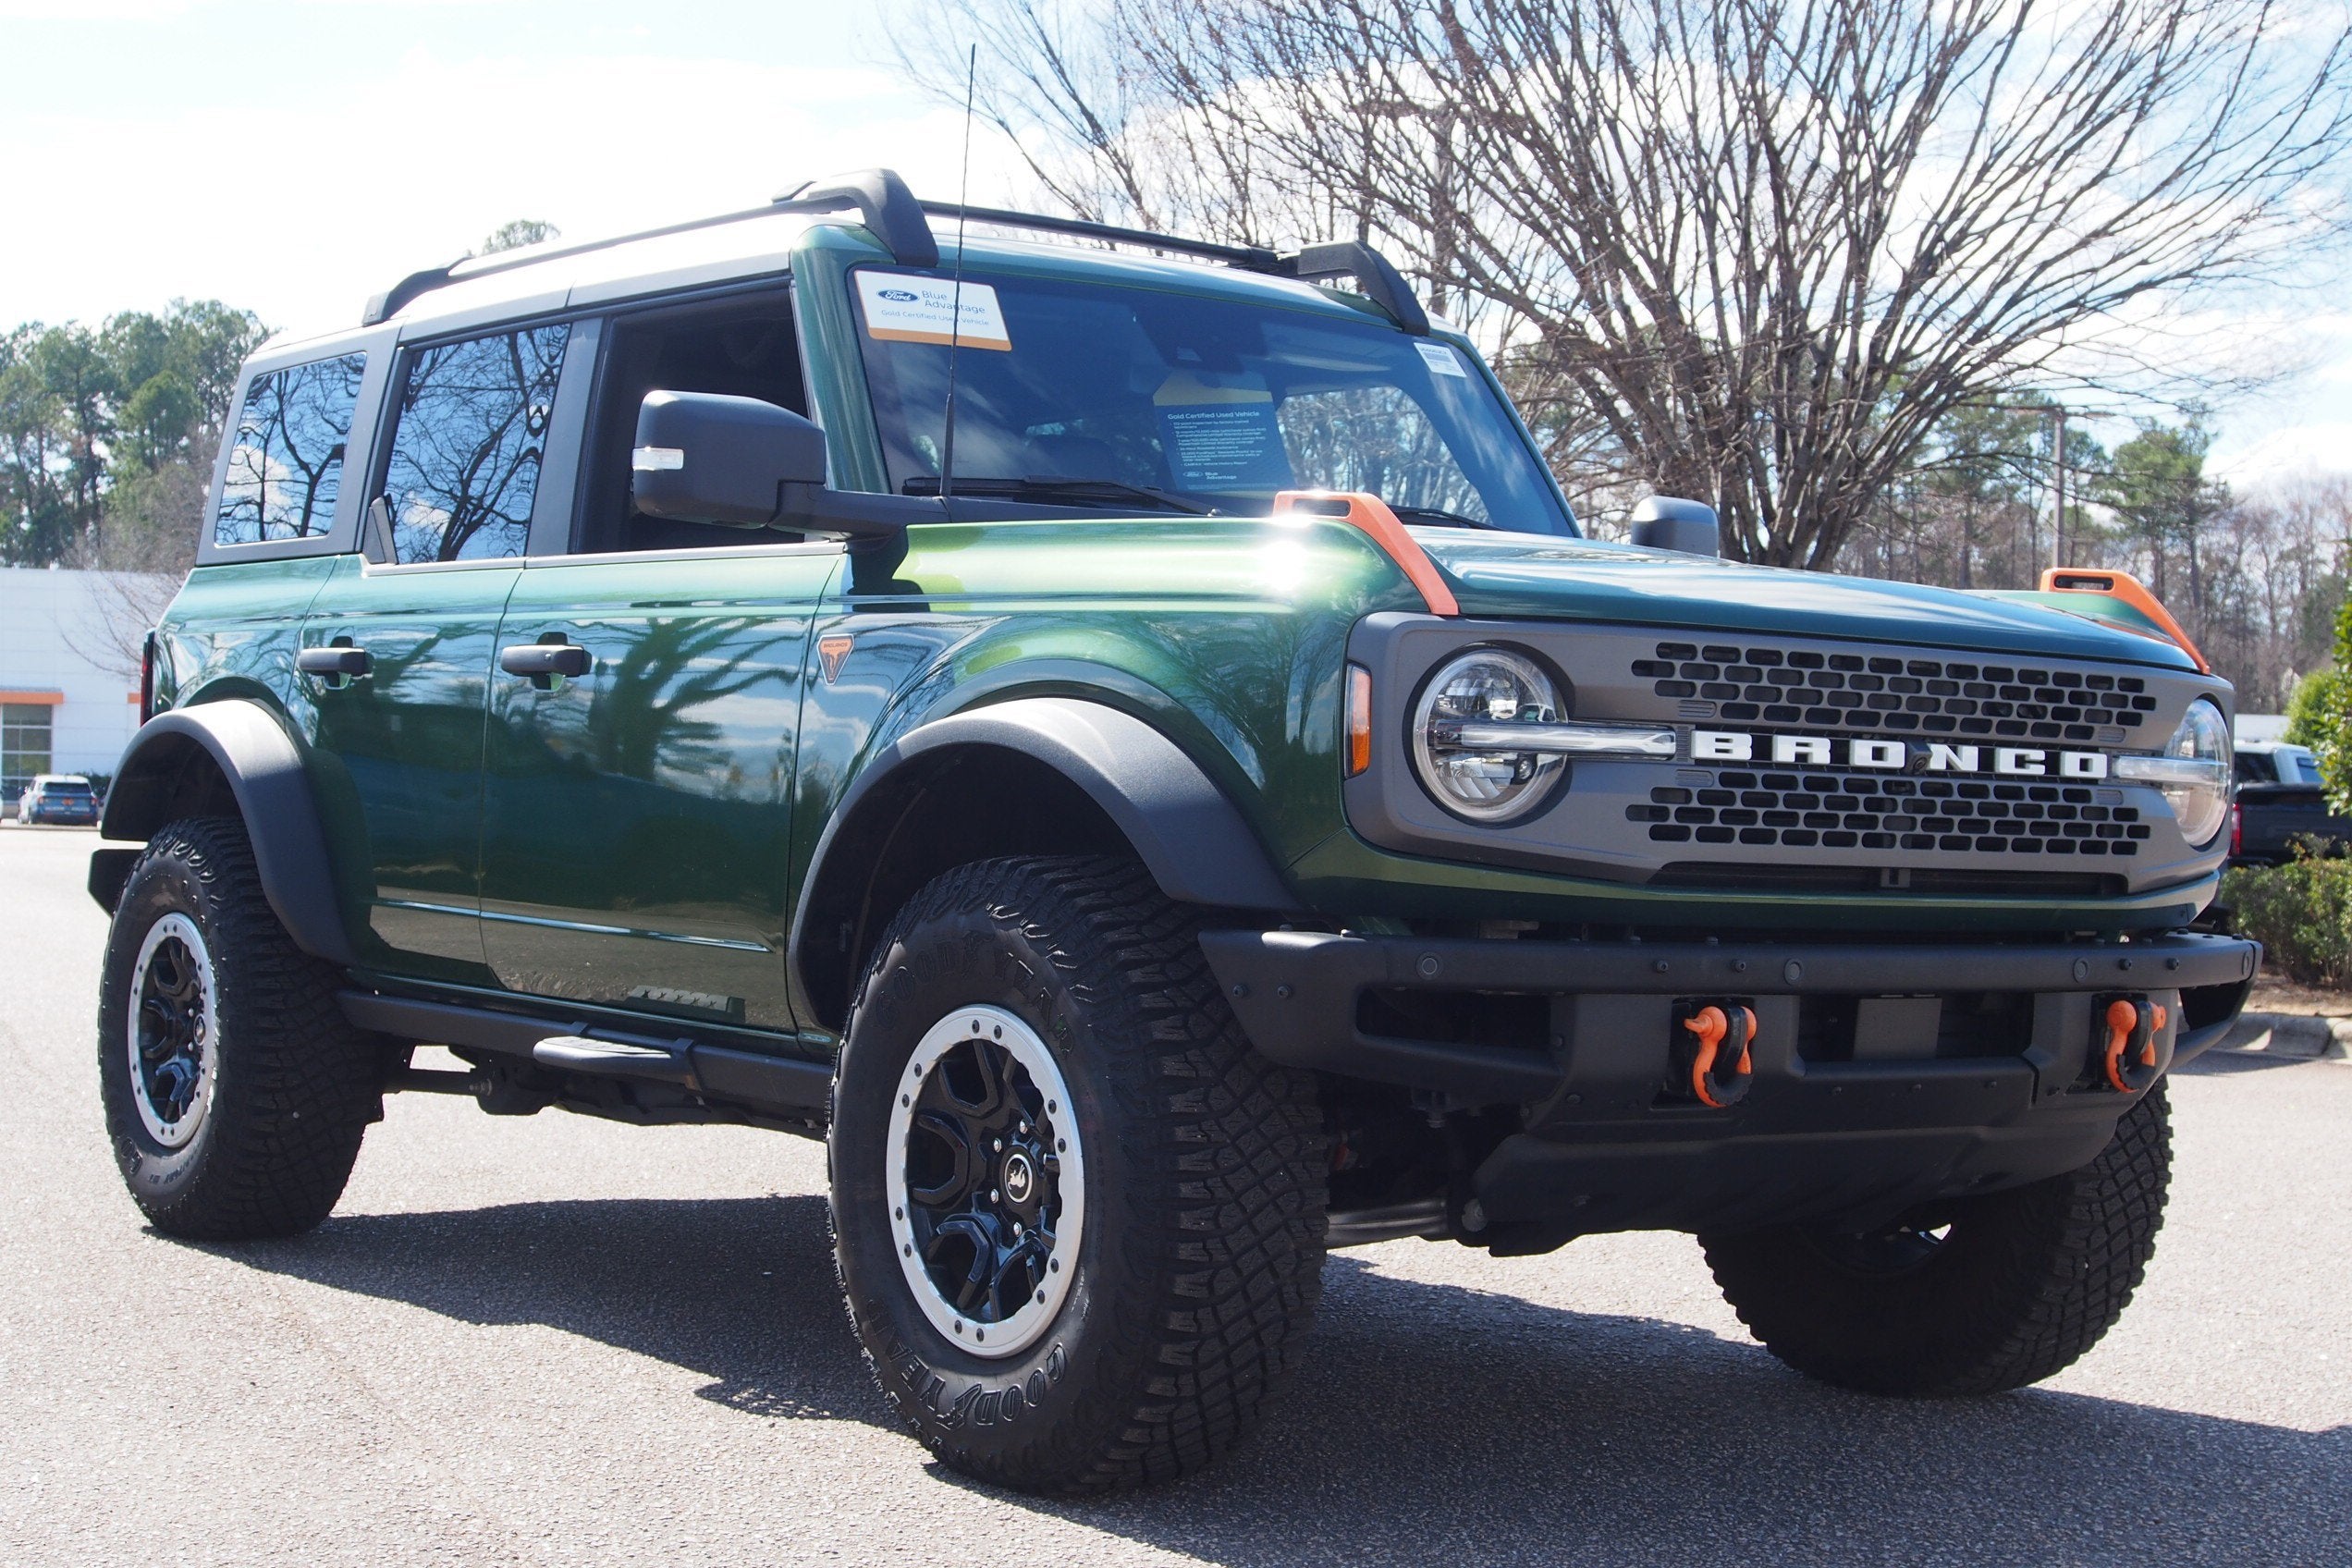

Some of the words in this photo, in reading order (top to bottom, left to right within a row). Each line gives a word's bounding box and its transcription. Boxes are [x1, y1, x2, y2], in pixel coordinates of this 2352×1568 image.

[882, 290, 914, 301] Ford
[922, 290, 948, 300] Blue
[881, 309, 900, 317] Gold
[902, 311, 937, 320] Certified
[938, 314, 959, 323] Use
[962, 317, 989, 325] Vehicle
[1690, 729, 2108, 779] BRONCO
